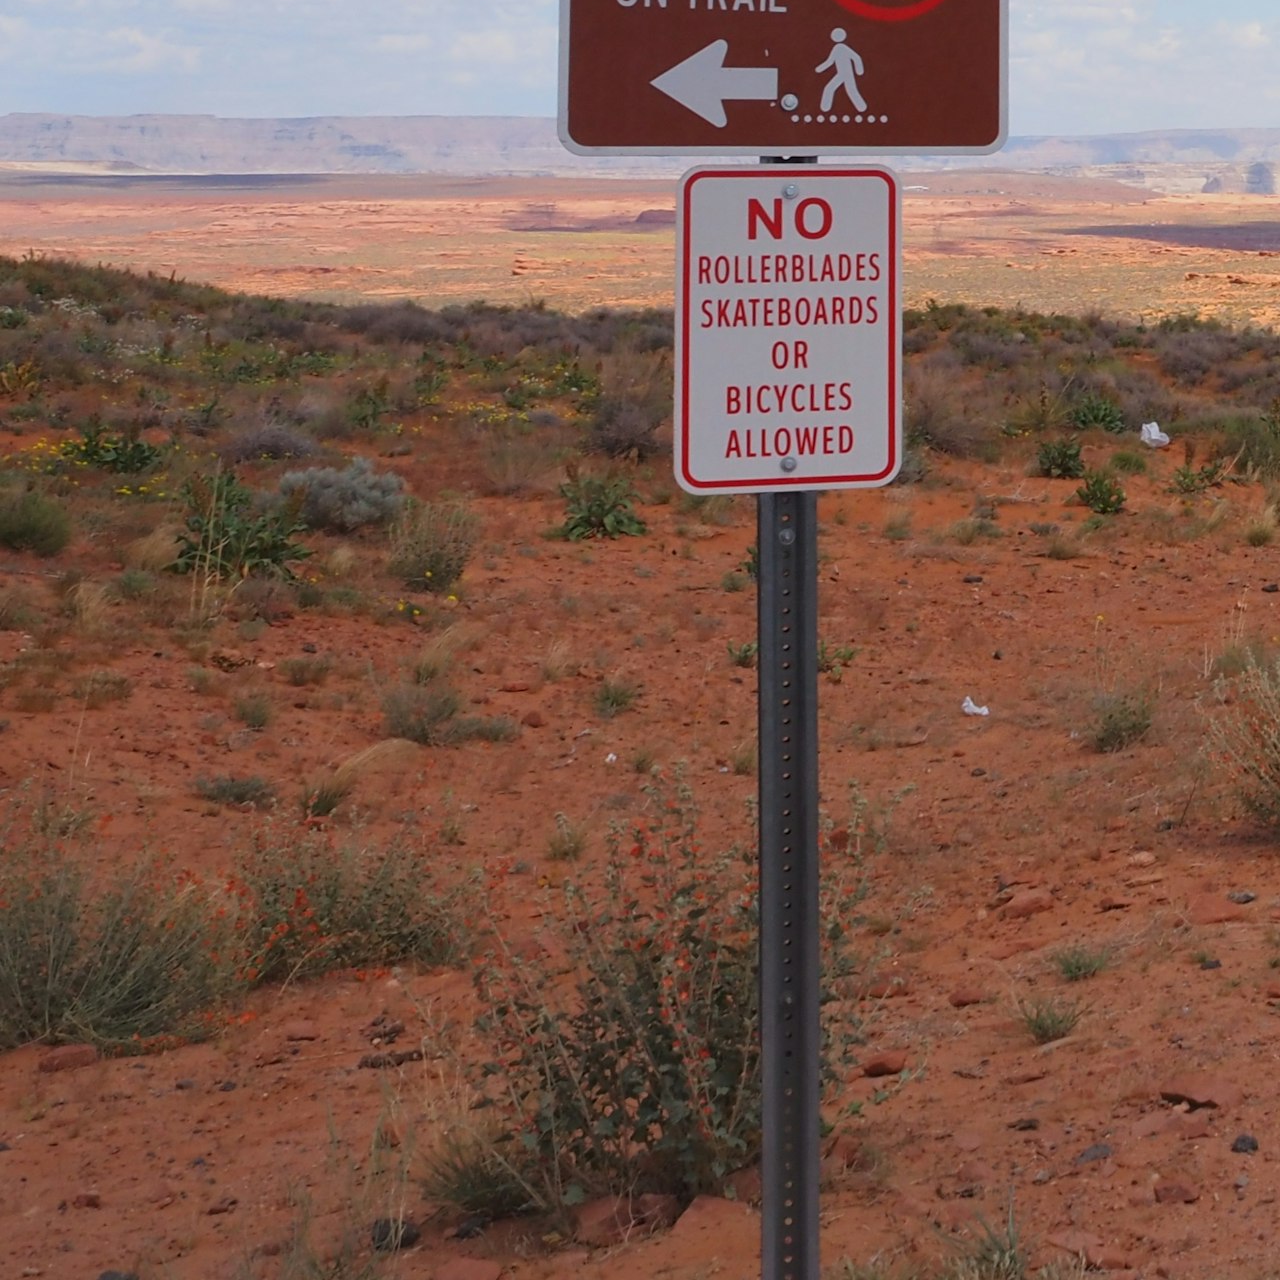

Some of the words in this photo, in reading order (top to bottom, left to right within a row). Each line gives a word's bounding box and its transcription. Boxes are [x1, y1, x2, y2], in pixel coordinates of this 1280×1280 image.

[747, 197, 833, 240] NO
[698, 253, 881, 285] ROLLERBLADES
[700, 296, 879, 328] SKATEBOARDS
[771, 340, 809, 370] OR
[726, 382, 853, 415] BICYCLES
[725, 425, 854, 458] ALLOWED
